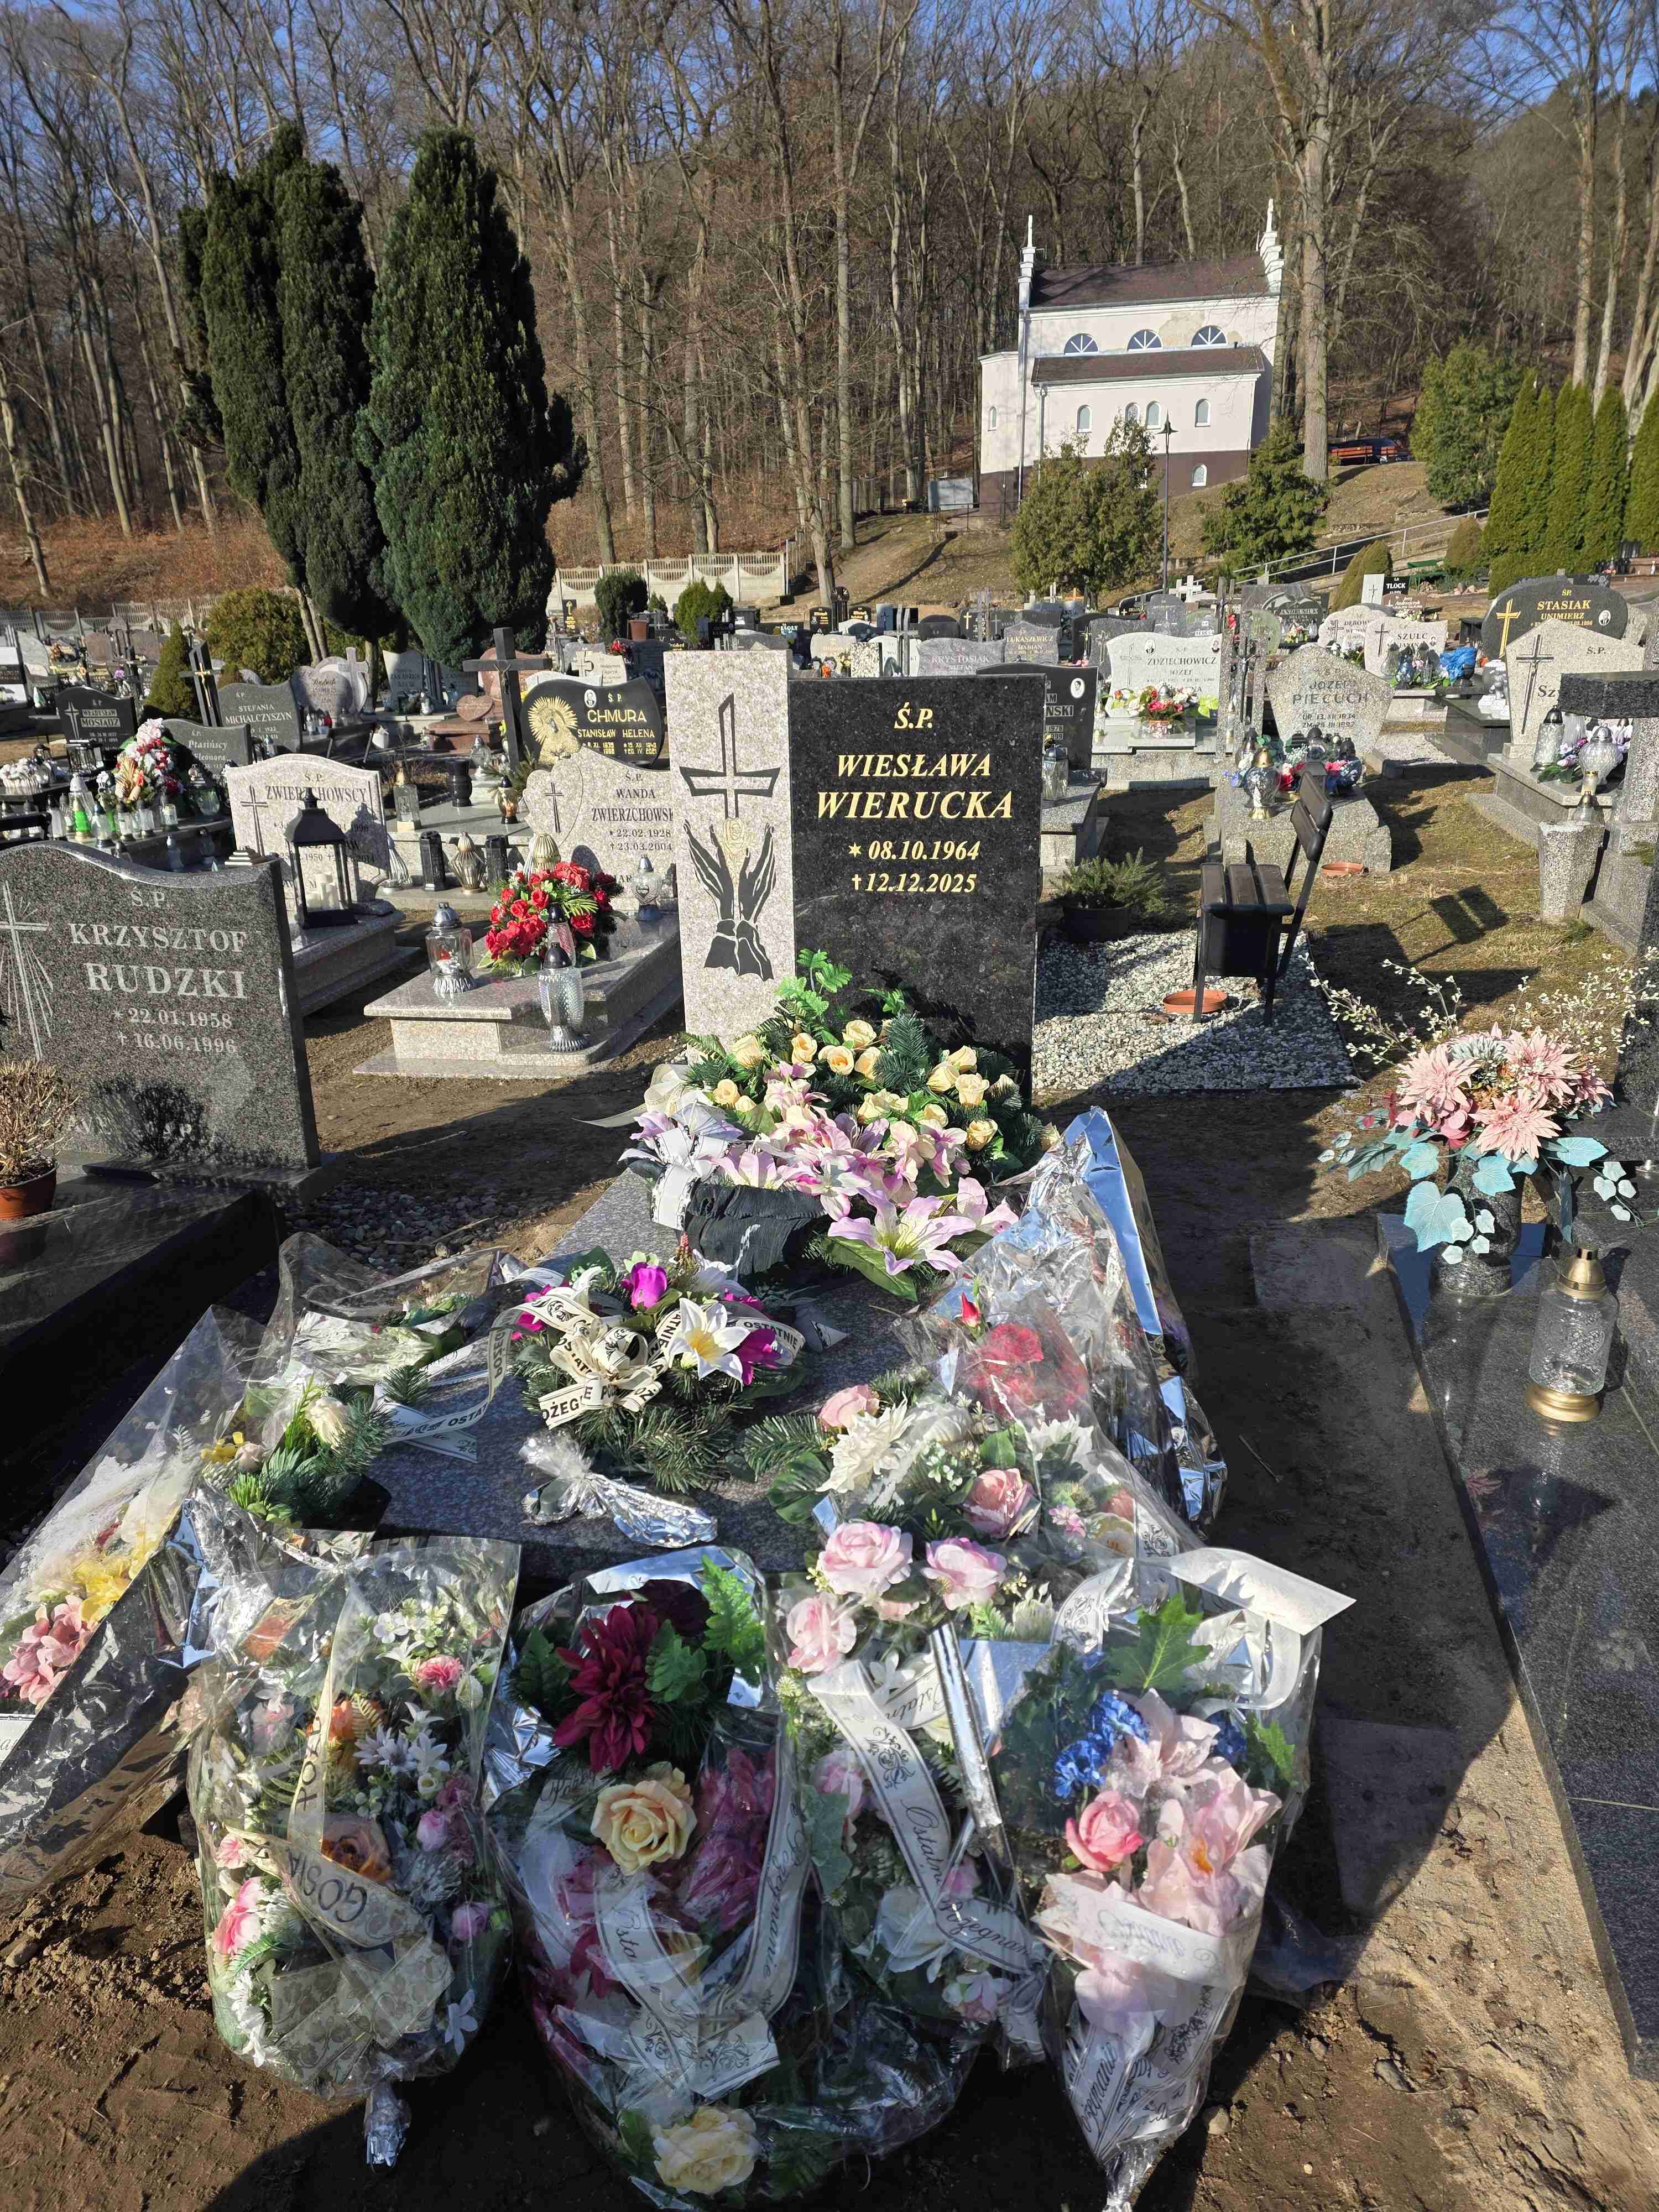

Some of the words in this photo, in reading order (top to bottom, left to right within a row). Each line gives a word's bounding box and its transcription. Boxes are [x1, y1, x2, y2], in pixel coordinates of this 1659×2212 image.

[1537, 599, 1592, 611] STASIAK
[225, 712, 293, 724] MICHALCZYSZYN
[238, 704, 274, 712] STEFANIA
[587, 709, 648, 723] CHMURA
[893, 701, 934, 729] Ś.P.
[577, 729, 616, 738] STANISŁAW
[622, 729, 655, 738] HELENA
[188, 739, 227, 751] Ptasińscy
[837, 752, 992, 778] WIESŁAWA
[616, 789, 656, 799] WANDA
[816, 790, 1013, 820] WIERUCKA
[616, 829, 672, 838] 22.02.1928
[618, 842, 672, 851] 23.03.2004
[868, 840, 981, 861] 08.10.1964
[865, 873, 978, 893] 12.12.2025
[69, 923, 248, 953] KRZYSZTOF
[83, 962, 248, 999] RUDZKI
[128, 1008, 233, 1029] 22.01.1958
[133, 1032, 237, 1053] 16.06.1996
[285, 1849, 368, 1923] GOSIA
